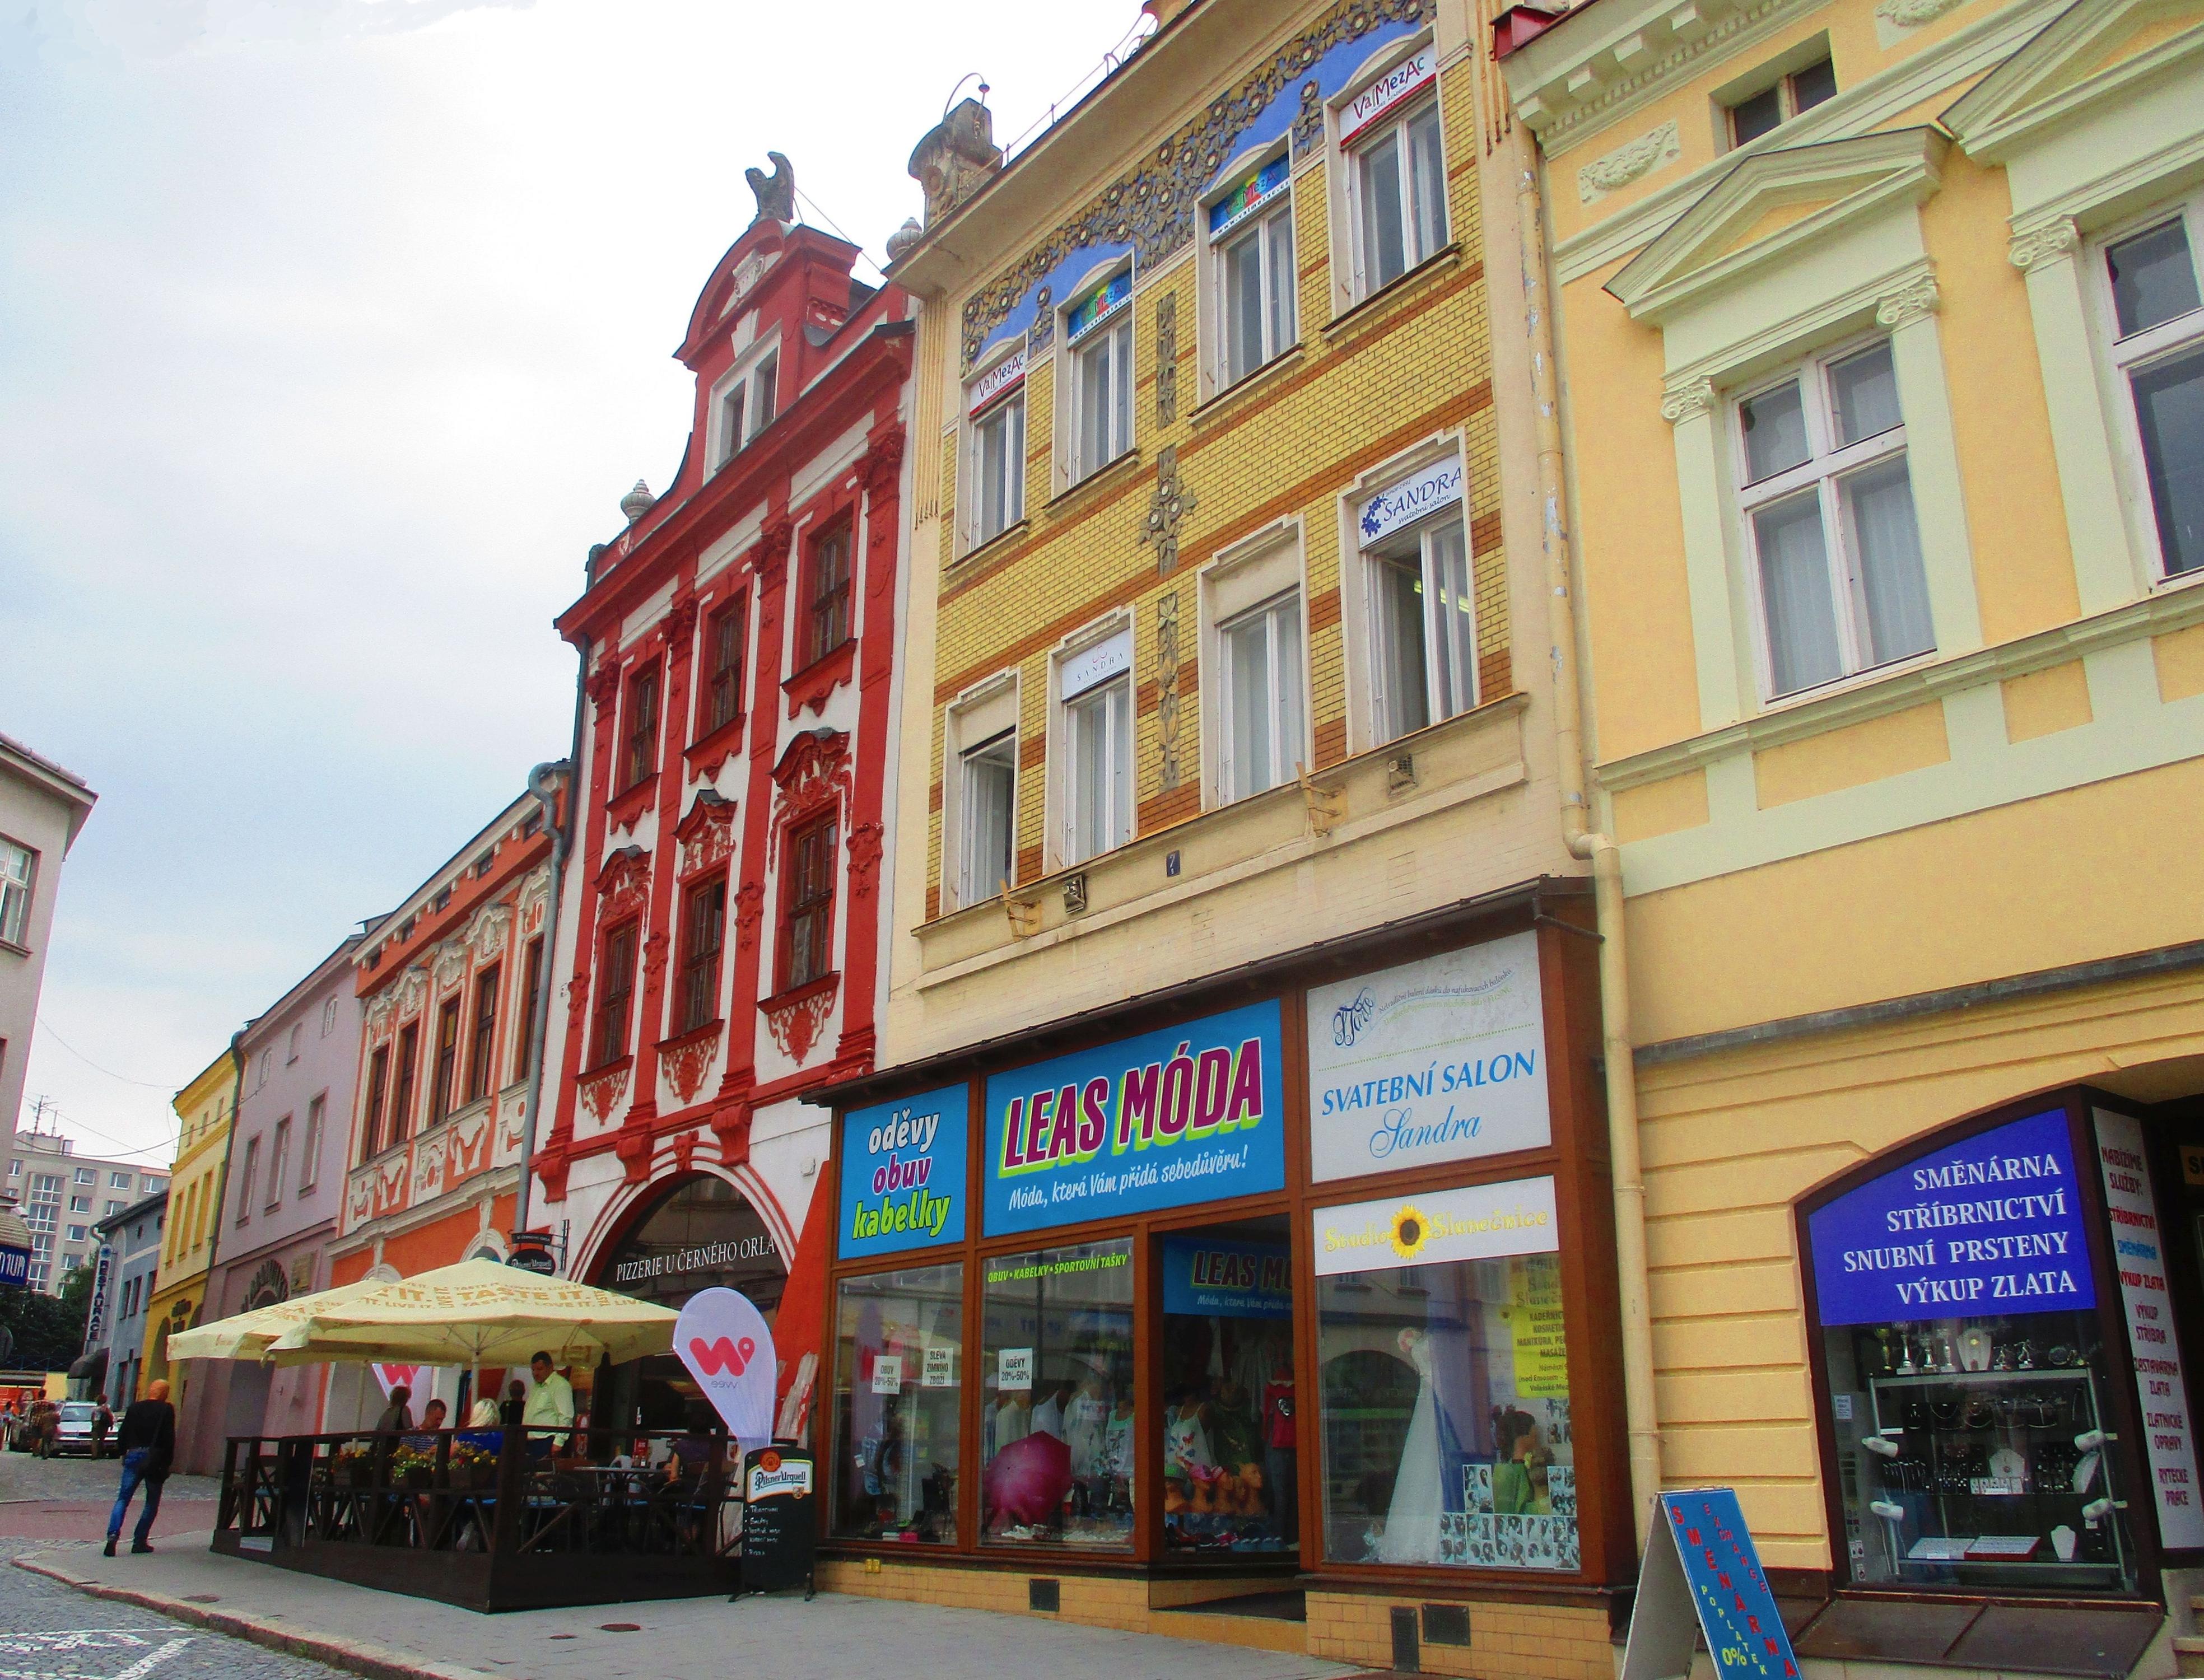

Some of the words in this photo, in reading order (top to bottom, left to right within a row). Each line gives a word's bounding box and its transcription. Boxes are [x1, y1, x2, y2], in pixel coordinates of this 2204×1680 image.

[1353, 56, 1425, 119] ValMezAc
[978, 354, 1024, 398] ValMezAc
[1383, 466, 1462, 522] SANDRA
[1429, 493, 1451, 510] salon
[1321, 1060, 1437, 1117] SVATEBNÍ
[1442, 1048, 1536, 1093] SALON
[999, 1075, 1110, 1175] LEAS
[1113, 1035, 1264, 1150] MÓDA
[868, 1107, 941, 1154] oděvy
[1369, 1104, 1482, 1159] Sandra
[872, 1151, 933, 1196] obuv
[1008, 1186, 1049, 1211] Móda,
[1052, 1175, 1088, 1203] která
[1089, 1171, 1117, 1197] Vám
[1119, 1165, 1159, 1196] přidá
[1161, 1144, 1249, 1183] sebedůvěru!
[1913, 1153, 2062, 1191] SMĚNÁRNA
[852, 1187, 952, 1240] kabelky
[1429, 1205, 1549, 1240] Slunečnice
[1886, 1187, 2067, 1232] STŘÍBRNICTVÍ
[1325, 1217, 1391, 1253] Studio
[1843, 1238, 1937, 1273] SNUBNÍ
[1947, 1231, 2068, 1264] PRSTENY
[616, 1256, 663, 1282] PIZZERIE
[665, 1254, 675, 1274] U
[677, 1240, 737, 1272] ČERNÉHO
[739, 1234, 776, 1259] ORLA
[987, 1271, 1009, 1283] OBUV
[1013, 1264, 1050, 1280] KABELKY
[1054, 1254, 1101, 1275] SPORTOVNÍ
[1101, 1252, 1128, 1268] TAŠKY
[1192, 1249, 1257, 1290] LEAS
[89, 1259, 110, 1340] RESTAURACE
[398, 1287, 433, 1303] IT.
[456, 1287, 550, 1301] TASTE
[557, 1290, 591, 1300] IT.
[1895, 1276, 1984, 1305] VÝKUP
[1991, 1269, 2077, 1299] ZLATA
[880, 1365, 894, 1375] OBUV
[929, 1350, 947, 1360] SLEVA
[1005, 1355, 1026, 1369] ODĚVY
[929, 1373, 945, 1385] ZBOŽÍ
[1000, 1371, 1030, 1382] 20%-50%
[754, 1471, 781, 1491] Pilsner
[781, 1471, 807, 1485] Urquell
[1671, 1505, 1797, 1678] SMĚNÁRNA
[1700, 1584, 1768, 1676] POPLATEK
[1721, 1646, 1748, 1667] 0%
